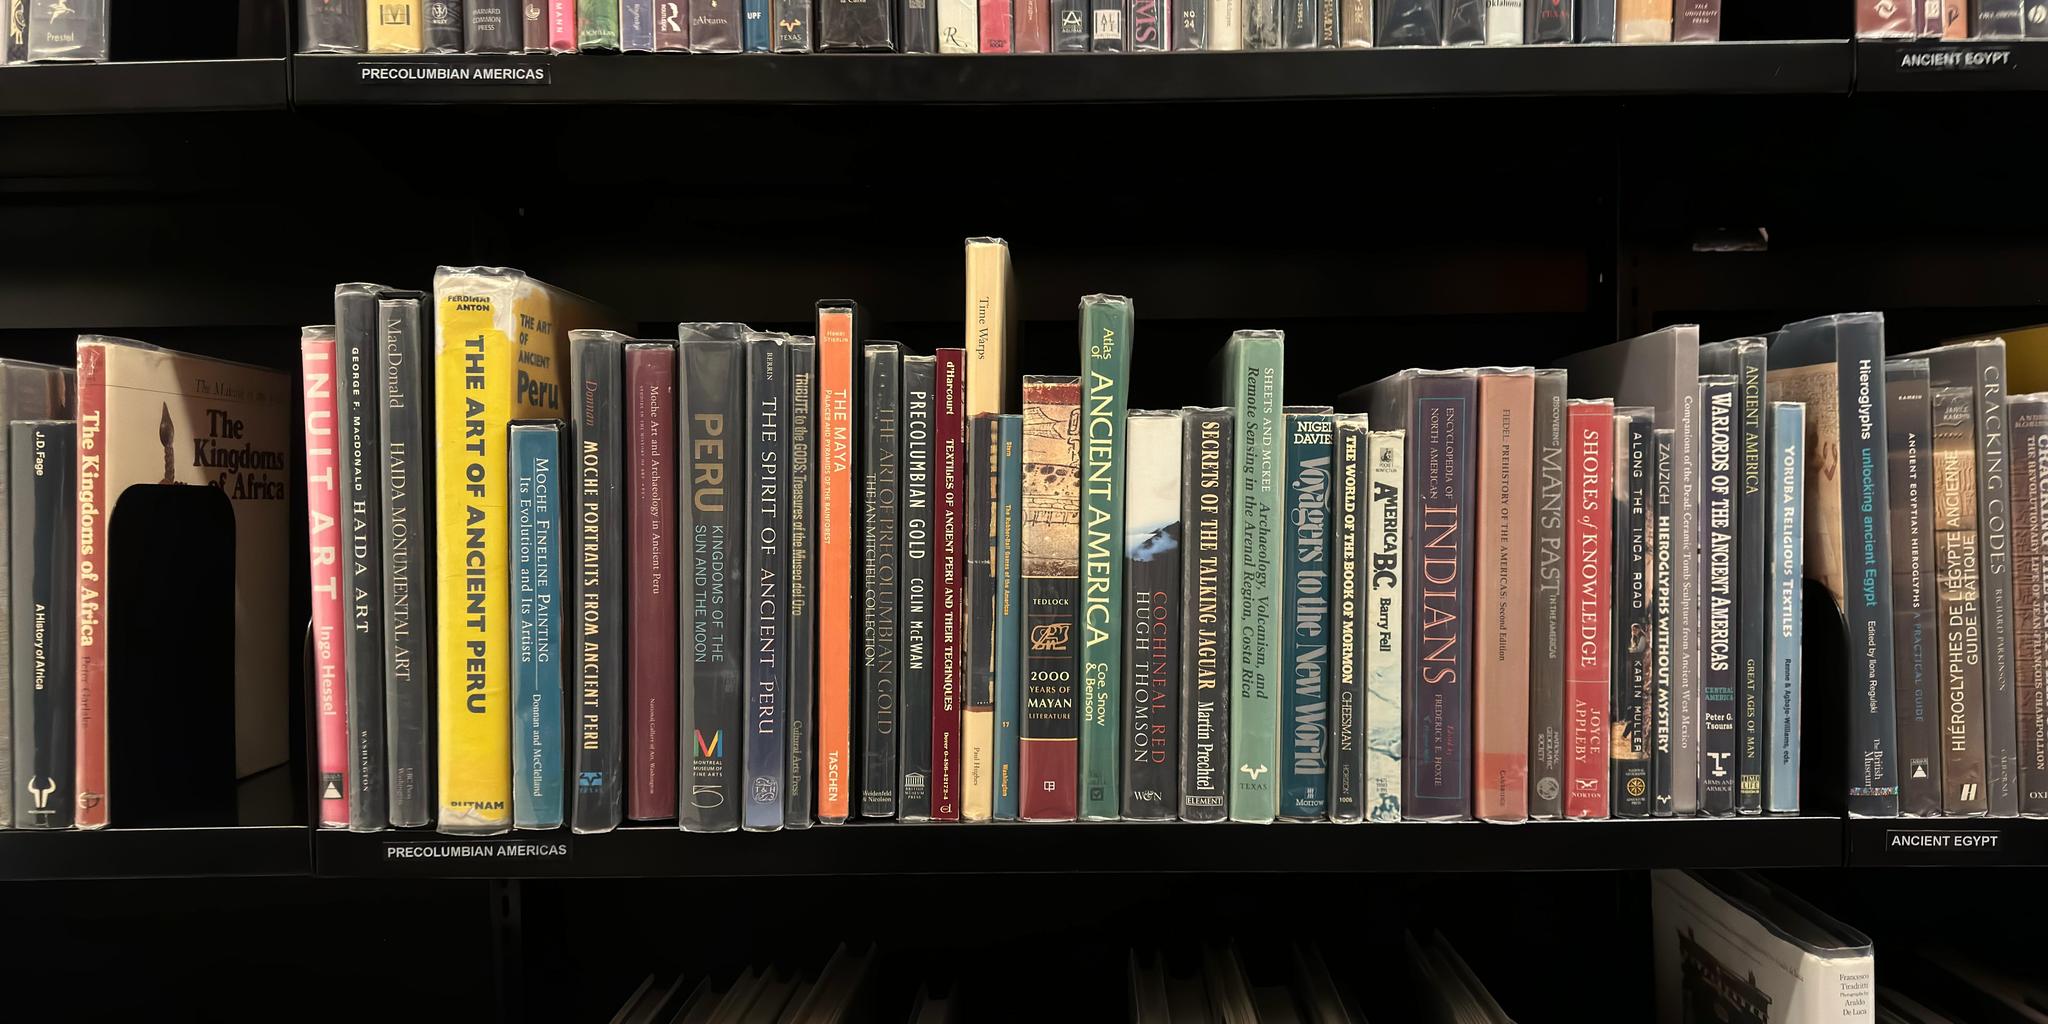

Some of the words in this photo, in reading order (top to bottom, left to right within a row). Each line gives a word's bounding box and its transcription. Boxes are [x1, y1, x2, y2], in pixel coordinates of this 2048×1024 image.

[47, 32, 74, 42] Prestel
[1901, 51, 1961, 67] ANCIENT
[1964, 51, 2011, 65] EGYPT
[362, 68, 469, 80] PRECOLUMBIAN
[473, 68, 544, 80] AMERICAS
[978, 297, 990, 325] Time
[387, 319, 404, 409] MacDonald
[465, 335, 485, 390] THE
[976, 328, 989, 361] Warps
[517, 369, 559, 410] Peru
[650, 386, 661, 418] Moche
[834, 388, 847, 421] THE
[1262, 368, 1274, 414] SHEETS
[1746, 365, 1759, 427] ANCIENT
[1857, 359, 1874, 440] Hieroglyphs
[36, 431, 45, 451] J.D.
[81, 410, 100, 449] The
[206, 408, 244, 440] The
[304, 352, 334, 490] INUIT
[466, 398, 485, 456] ART
[651, 420, 661, 437] Art
[761, 397, 777, 442] THE
[1088, 370, 1114, 501] ANCIENT
[1262, 418, 1273, 446] AND
[1711, 392, 1732, 471] WARLORDS
[1984, 365, 2003, 490] CRACKING
[34, 452, 45, 476] Fage
[192, 438, 285, 474] Kingdoms
[584, 441, 599, 496] MOCHE
[651, 439, 661, 457] and
[694, 412, 724, 512] PERU
[834, 426, 847, 472] MAYA
[909, 391, 927, 508] PRECOLUMBIAN
[945, 439, 955, 490] TEXTILES
[1201, 421, 1220, 490] SECRETS
[1582, 428, 1599, 511] SHORES
[1746, 432, 1758, 495] AMERICA
[231, 472, 285, 500] Africa
[390, 442, 406, 501] HAIDA
[466, 462, 485, 497] OF
[536, 457, 550, 513] MOCHE
[648, 459, 661, 517] Archaeology
[761, 451, 776, 518] SPIRIT
[1711, 475, 1730, 495] OF
[1783, 445, 1795, 504] YORUBA
[1859, 448, 1875, 512] unlocking
[79, 453, 100, 555] Kingdoms
[945, 492, 954, 507] OF
[1201, 493, 1219, 514] OF
[1291, 455, 1331, 562] Voyagers
[1577, 515, 1598, 529] of
[1711, 498, 1730, 528] THE
[354, 500, 367, 576] HAIDA
[584, 503, 599, 587] PORTRAITS
[652, 520, 662, 530] in
[760, 527, 776, 555] OF
[909, 519, 926, 559] GOLD
[945, 509, 954, 552] ANCIENT
[1200, 520, 1218, 551] THE
[1783, 507, 1794, 576] RELIGIOUS
[1863, 516, 1876, 564] ancient
[1988, 499, 2006, 575] CODES
[81, 560, 99, 580] of
[311, 509, 337, 601] ART
[391, 507, 408, 641] MONUMENTAL
[467, 505, 485, 632] ANCIENT
[536, 520, 550, 587] FINELINE
[652, 533, 662, 570] Ancient
[944, 556, 954, 585] PERU
[1659, 515, 1670, 615] HIEROGLYPHS
[1711, 531, 1732, 595] ANCIENT
[652, 573, 663, 595] Peru
[910, 578, 924, 613] COLIN
[944, 587, 954, 609] AND
[1087, 504, 1111, 648] AMERICA
[1199, 556, 1218, 623] TALKING
[1297, 570, 1327, 594] to
[1423, 503, 1458, 685] INDIANS
[1863, 568, 1878, 608] Egypt
[35, 604, 45, 612] A
[80, 586, 99, 646] Africa
[355, 587, 368, 634] ART
[585, 593, 599, 635] FROM
[760, 568, 775, 668] ANCIENT
[1032, 598, 1070, 606] TEDLOCK
[1136, 591, 1150, 651] HUGH
[1296, 597, 1328, 637] the
[1376, 597, 1391, 630] Barry
[1581, 533, 1598, 667] KNOWLEDGE
[1782, 579, 1794, 638] TEXTILES
[34, 613, 45, 649] History
[318, 626, 334, 660] Ingo
[537, 594, 551, 663] PAINTING
[910, 621, 924, 670] McEWAN
[944, 611, 953, 643] THEIR
[1379, 631, 1391, 652] Fell
[1710, 596, 1731, 671] AMERICAS
[35, 649, 45, 660] of
[35, 661, 45, 690] Africa
[395, 644, 411, 682] ART
[585, 641, 599, 707] ANCIENT
[1151, 591, 1168, 714] COCHINEAL
[1198, 629, 1217, 690] JAGUAR
[1295, 642, 1327, 699] New
[1658, 618, 1669, 687] WITHOUT
[321, 665, 336, 716] Hessel
[467, 640, 487, 714] PERU
[943, 645, 953, 711] TECHNIQUES
[1029, 685, 1056, 693] YEARS
[1058, 685, 1071, 693] OF
[1030, 671, 1070, 682] 2000
[1633, 660, 1642, 698] KARIN
[533, 694, 542, 728] Donnan
[759, 681, 775, 734] PERU
[1027, 697, 1073, 708] MAYAN
[1134, 663, 1149, 763] THOMSON
[1197, 701, 1214, 740] Martín
[1341, 691, 1353, 751] CHEESMAN
[1658, 689, 1669, 753] MYSTERY
[533, 730, 542, 746] and
[584, 715, 599, 750] PERU
[1151, 725, 1166, 764] RED
[1294, 700, 1328, 776] World
[1575, 699, 1587, 763] APPLEBY
[1590, 708, 1601, 754] JOYCE
[1634, 706, 1642, 752] MULLER
[361, 730, 369, 793] WASHINGTON
[533, 749, 543, 797] McClelland
[828, 750, 839, 802] TASCHEN
[972, 762, 981, 786] Hughes
[973, 747, 981, 760] Paul
[1197, 743, 1213, 791] Prechtel
[387, 845, 494, 859] PRECOLUMBIAN
[496, 844, 567, 857] AMERICAS
[1891, 835, 1951, 847] ANCIENT
[1954, 835, 1999, 847] EGYPT
